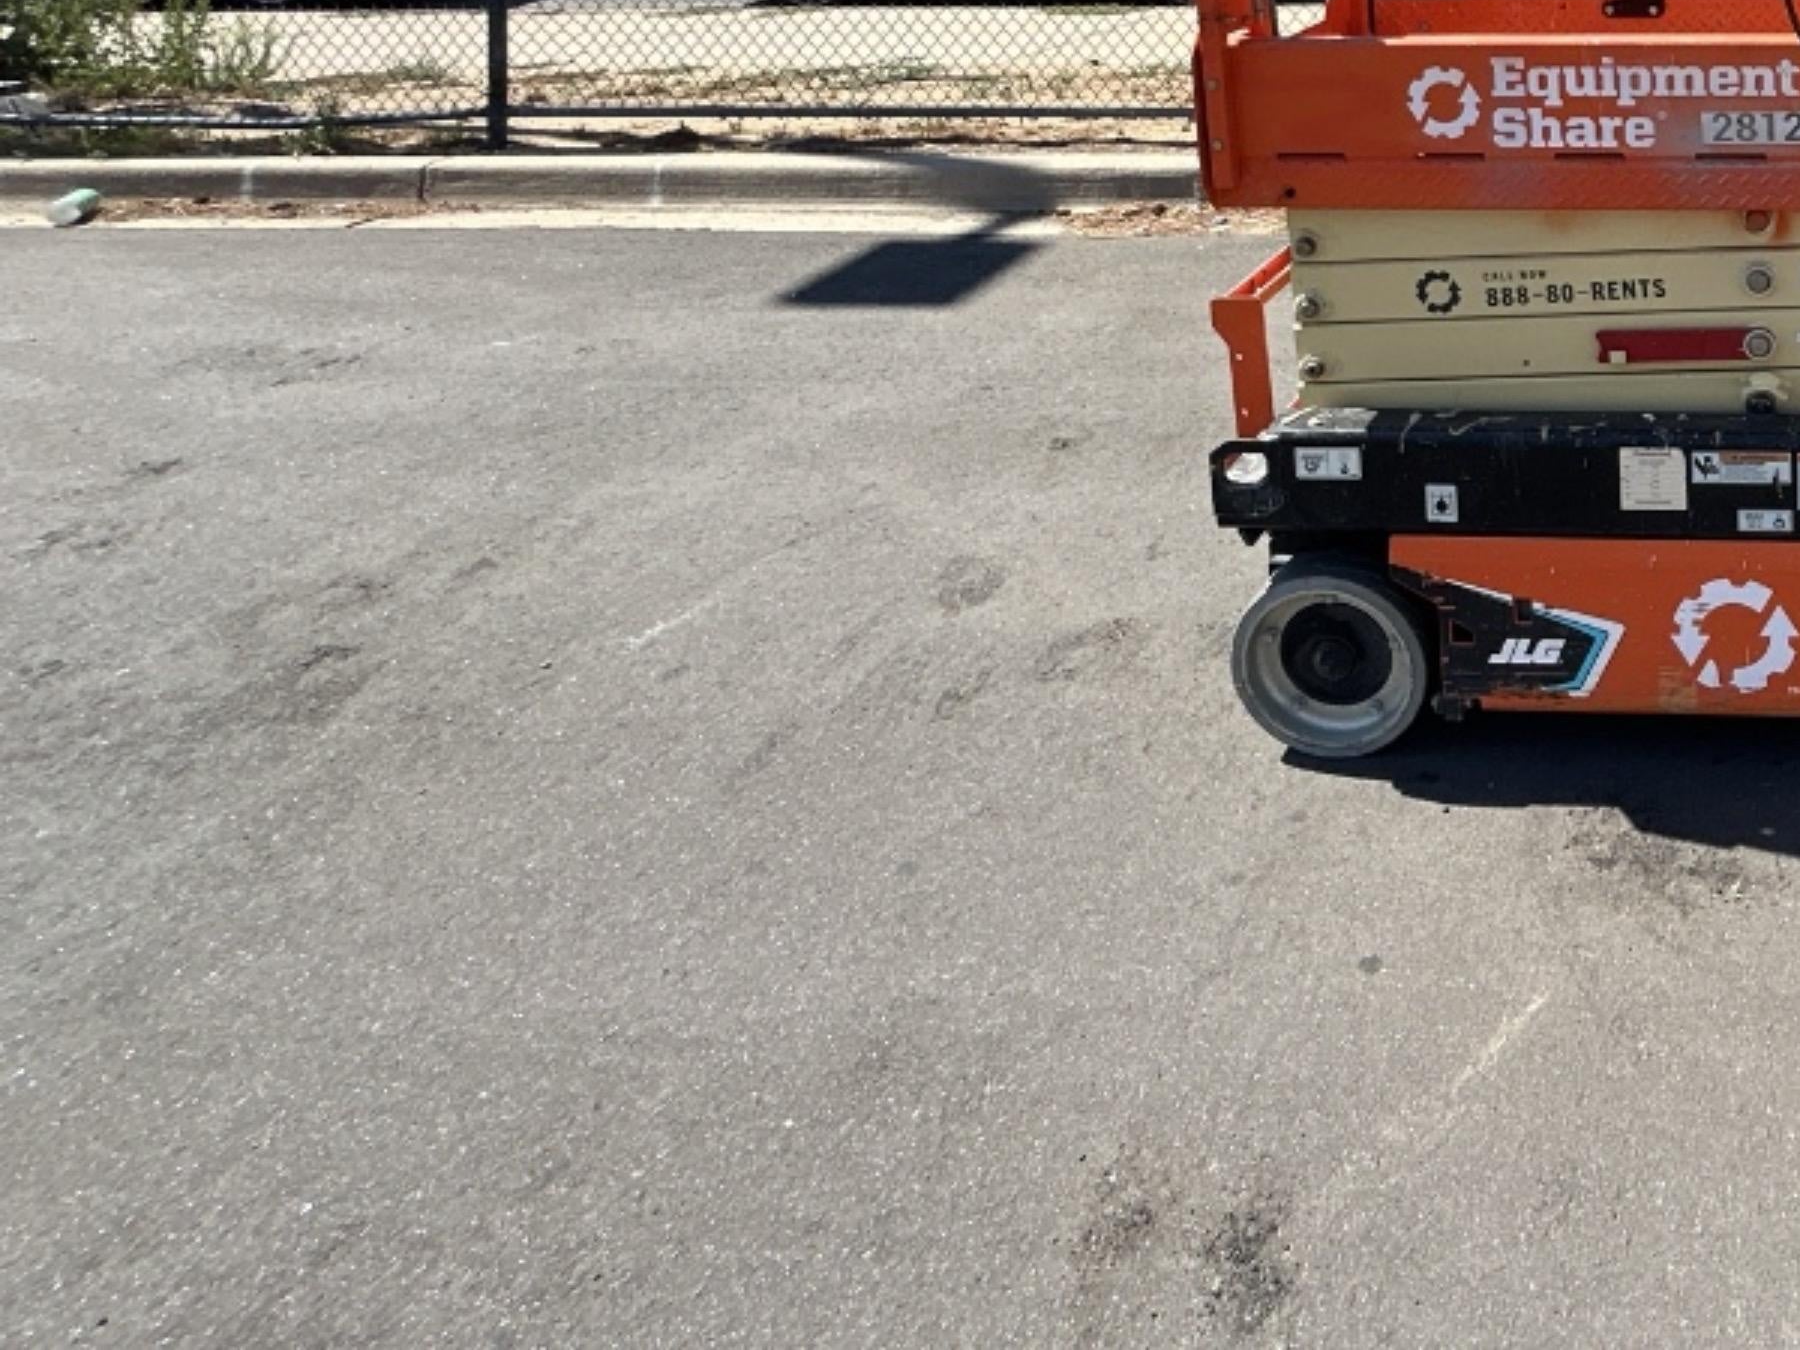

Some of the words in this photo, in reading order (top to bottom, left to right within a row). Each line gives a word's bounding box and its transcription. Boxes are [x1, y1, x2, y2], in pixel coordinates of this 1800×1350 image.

[1489, 55, 1800, 106] Equipment
[1492, 106, 1657, 148] Share
[1485, 278, 1667, 308] 888-80-RENTS
[1487, 638, 1567, 664] JLG
